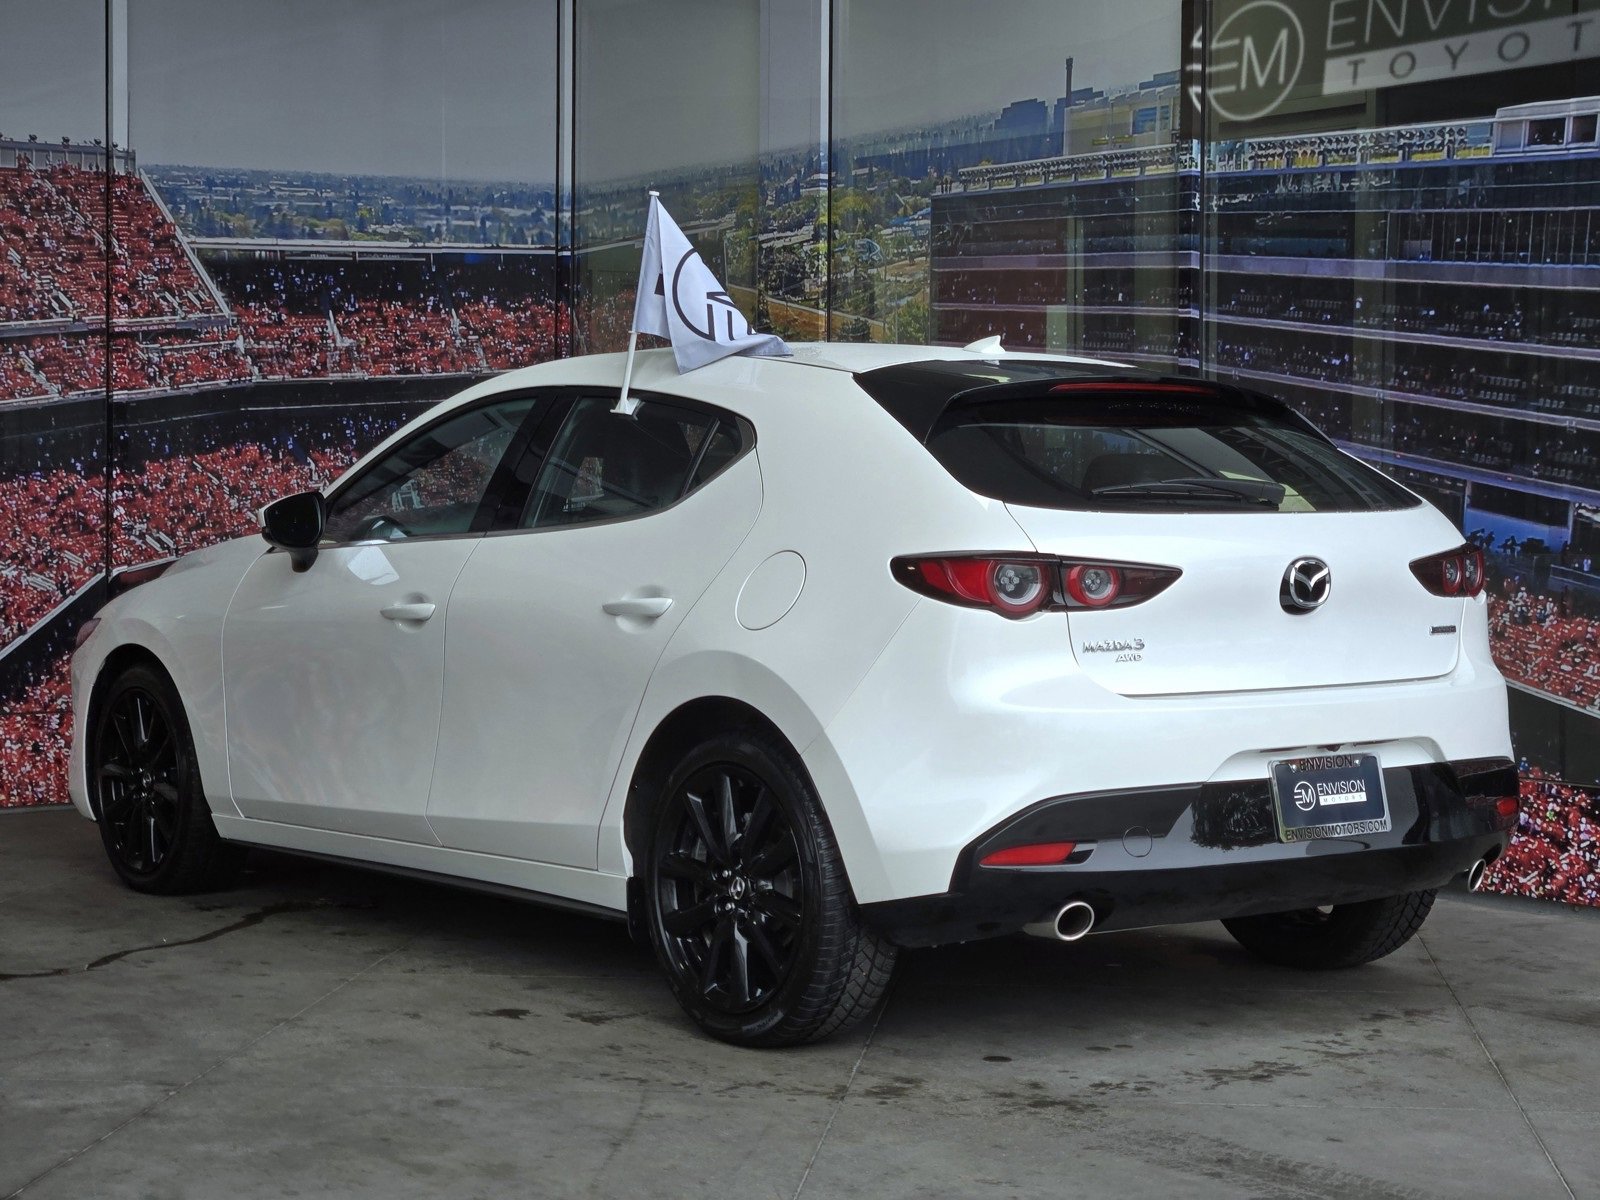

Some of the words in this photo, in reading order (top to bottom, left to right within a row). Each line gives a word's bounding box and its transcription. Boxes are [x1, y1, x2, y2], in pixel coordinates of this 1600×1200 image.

[1327, 0, 1551, 50] ENV
[1348, 19, 1594, 86] TOYOT
[1116, 654, 1143, 662] AWD
[1300, 754, 1352, 771] ENVISION
[1317, 779, 1366, 796] ENVISION
